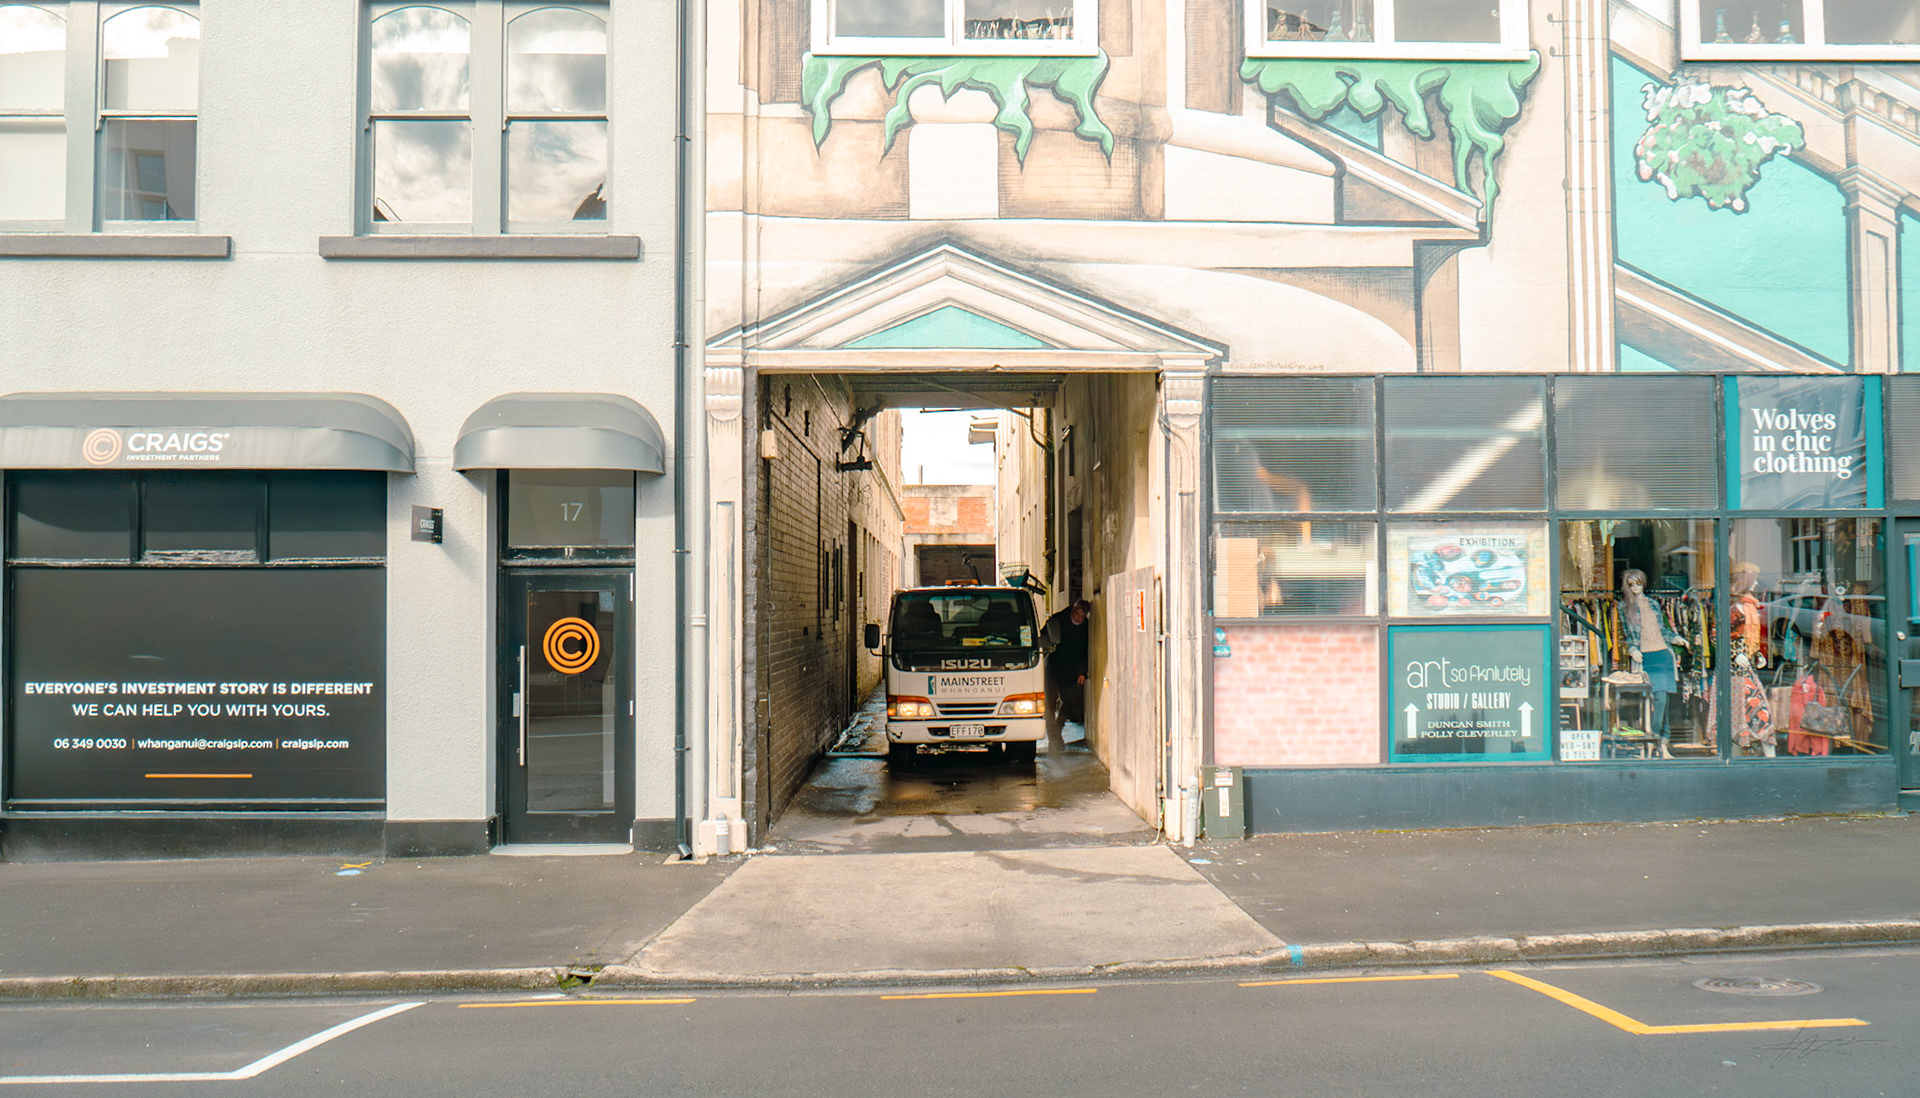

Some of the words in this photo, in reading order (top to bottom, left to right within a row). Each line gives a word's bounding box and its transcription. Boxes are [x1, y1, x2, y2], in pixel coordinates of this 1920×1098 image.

[1750, 408, 1836, 430] Wolves
[128, 432, 224, 452] CRAIGS
[1752, 429, 1776, 452] in
[1782, 429, 1832, 452] chic
[1754, 450, 1852, 480] clothing
[561, 502, 584, 521] 17
[1459, 537, 1515, 547] EXHIBITION
[941, 659, 992, 670] ISUZU
[1407, 657, 1451, 688] art
[1451, 668, 1467, 682] so
[940, 677, 1005, 686] MAINSTREET
[25, 682, 118, 694] EVERYONE'S
[122, 682, 216, 694] INVESTMENT
[220, 682, 268, 694] STORY
[272, 682, 286, 694] IS
[291, 682, 373, 694] DIFFERENT
[1427, 692, 1459, 710] STUDIO
[1463, 693, 1468, 709] /
[1472, 692, 1511, 709] GALLERY
[72, 704, 98, 716] WE
[103, 704, 136, 716] CAN
[142, 704, 182, 716] HELP
[188, 704, 220, 716] YOU
[225, 704, 267, 716] WITH
[272, 704, 330, 716] YOURS.
[1427, 721, 1473, 729] DUNCAN
[1476, 720, 1510, 728] SMITH
[951, 727, 983, 735] EFF170
[1456, 730, 1518, 738] CLEVERLEY
[54, 738, 69, 749] 06
[72, 738, 93, 749] 349
[96, 738, 126, 749] 0030
[138, 738, 272, 750] whanganui@craigsip.com
[282, 738, 349, 750] craigsip.com
